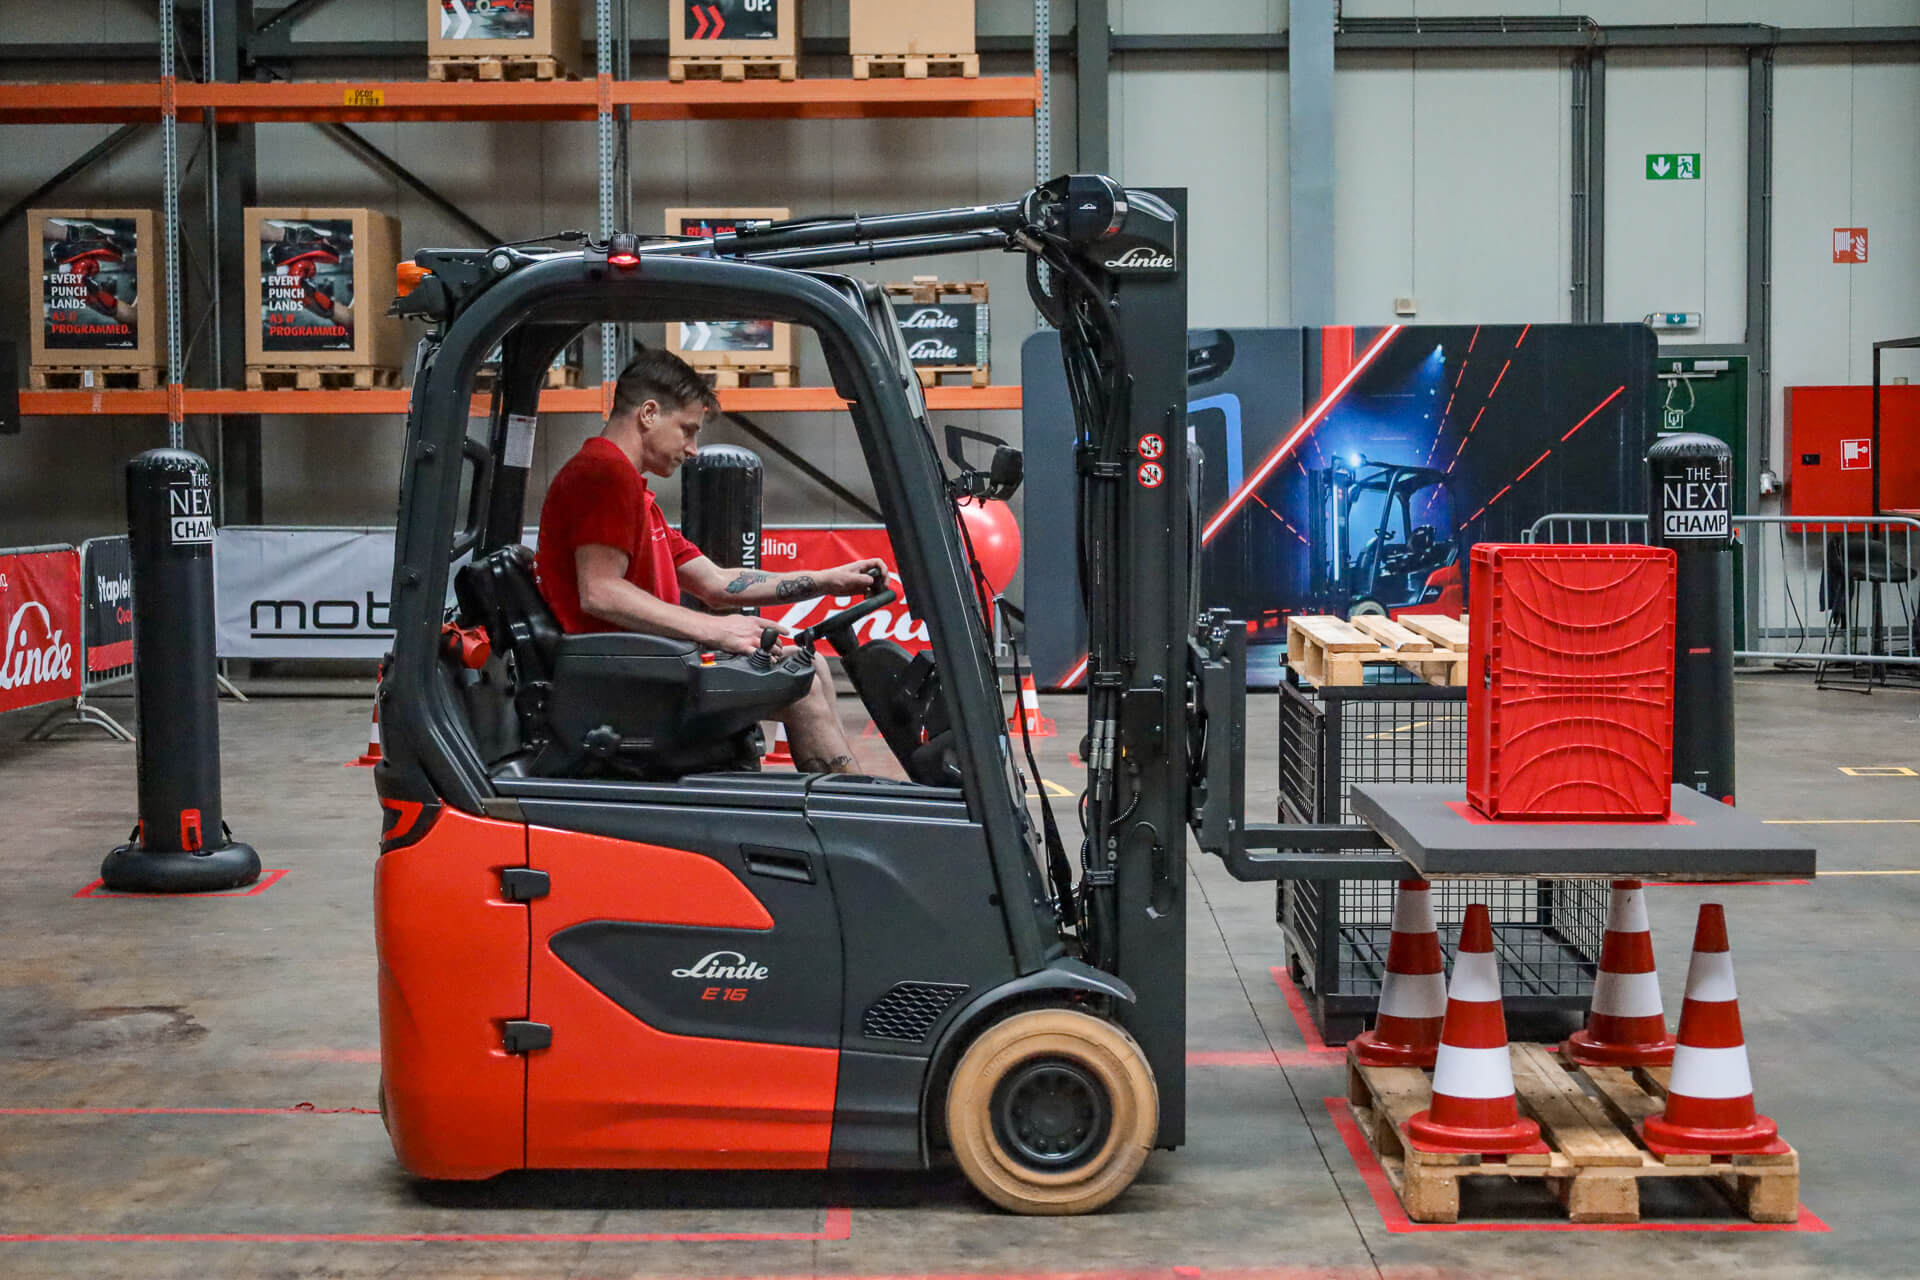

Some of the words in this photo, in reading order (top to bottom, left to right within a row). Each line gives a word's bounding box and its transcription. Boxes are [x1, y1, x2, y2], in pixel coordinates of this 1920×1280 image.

[1104, 247, 1173, 268] Linde
[51, 274, 82, 284] EVERY
[268, 275, 301, 286] EVERY
[51, 286, 87, 297] PUNCH
[268, 288, 305, 299] PUNCH
[51, 298, 87, 309] LANDS
[269, 300, 304, 312] LANDS
[897, 308, 959, 329] Linde
[908, 338, 958, 359] Linde
[191, 472, 209, 487] THE
[1685, 466, 1711, 481] THE
[1663, 482, 1728, 509] NEXT
[1666, 514, 1727, 533] CHAMP
[0, 601, 72, 690] Linde
[671, 950, 769, 980] Linde
[701, 987, 720, 1000] E
